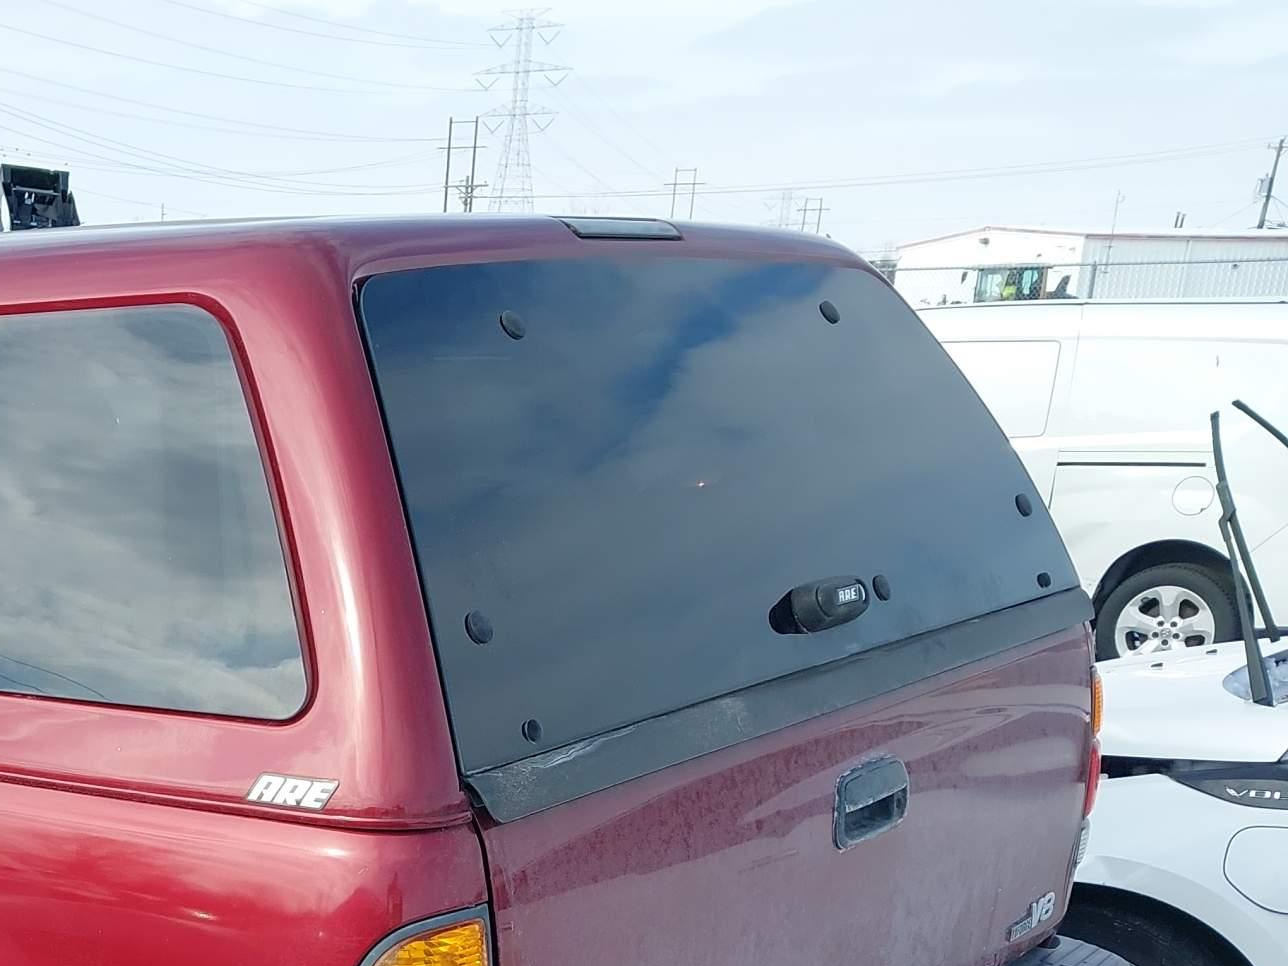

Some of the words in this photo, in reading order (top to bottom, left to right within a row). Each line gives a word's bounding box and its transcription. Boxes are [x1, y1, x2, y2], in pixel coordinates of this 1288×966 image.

[838, 587, 857, 602] ARE
[246, 774, 337, 809] ARE
[1031, 891, 1055, 929] V8
